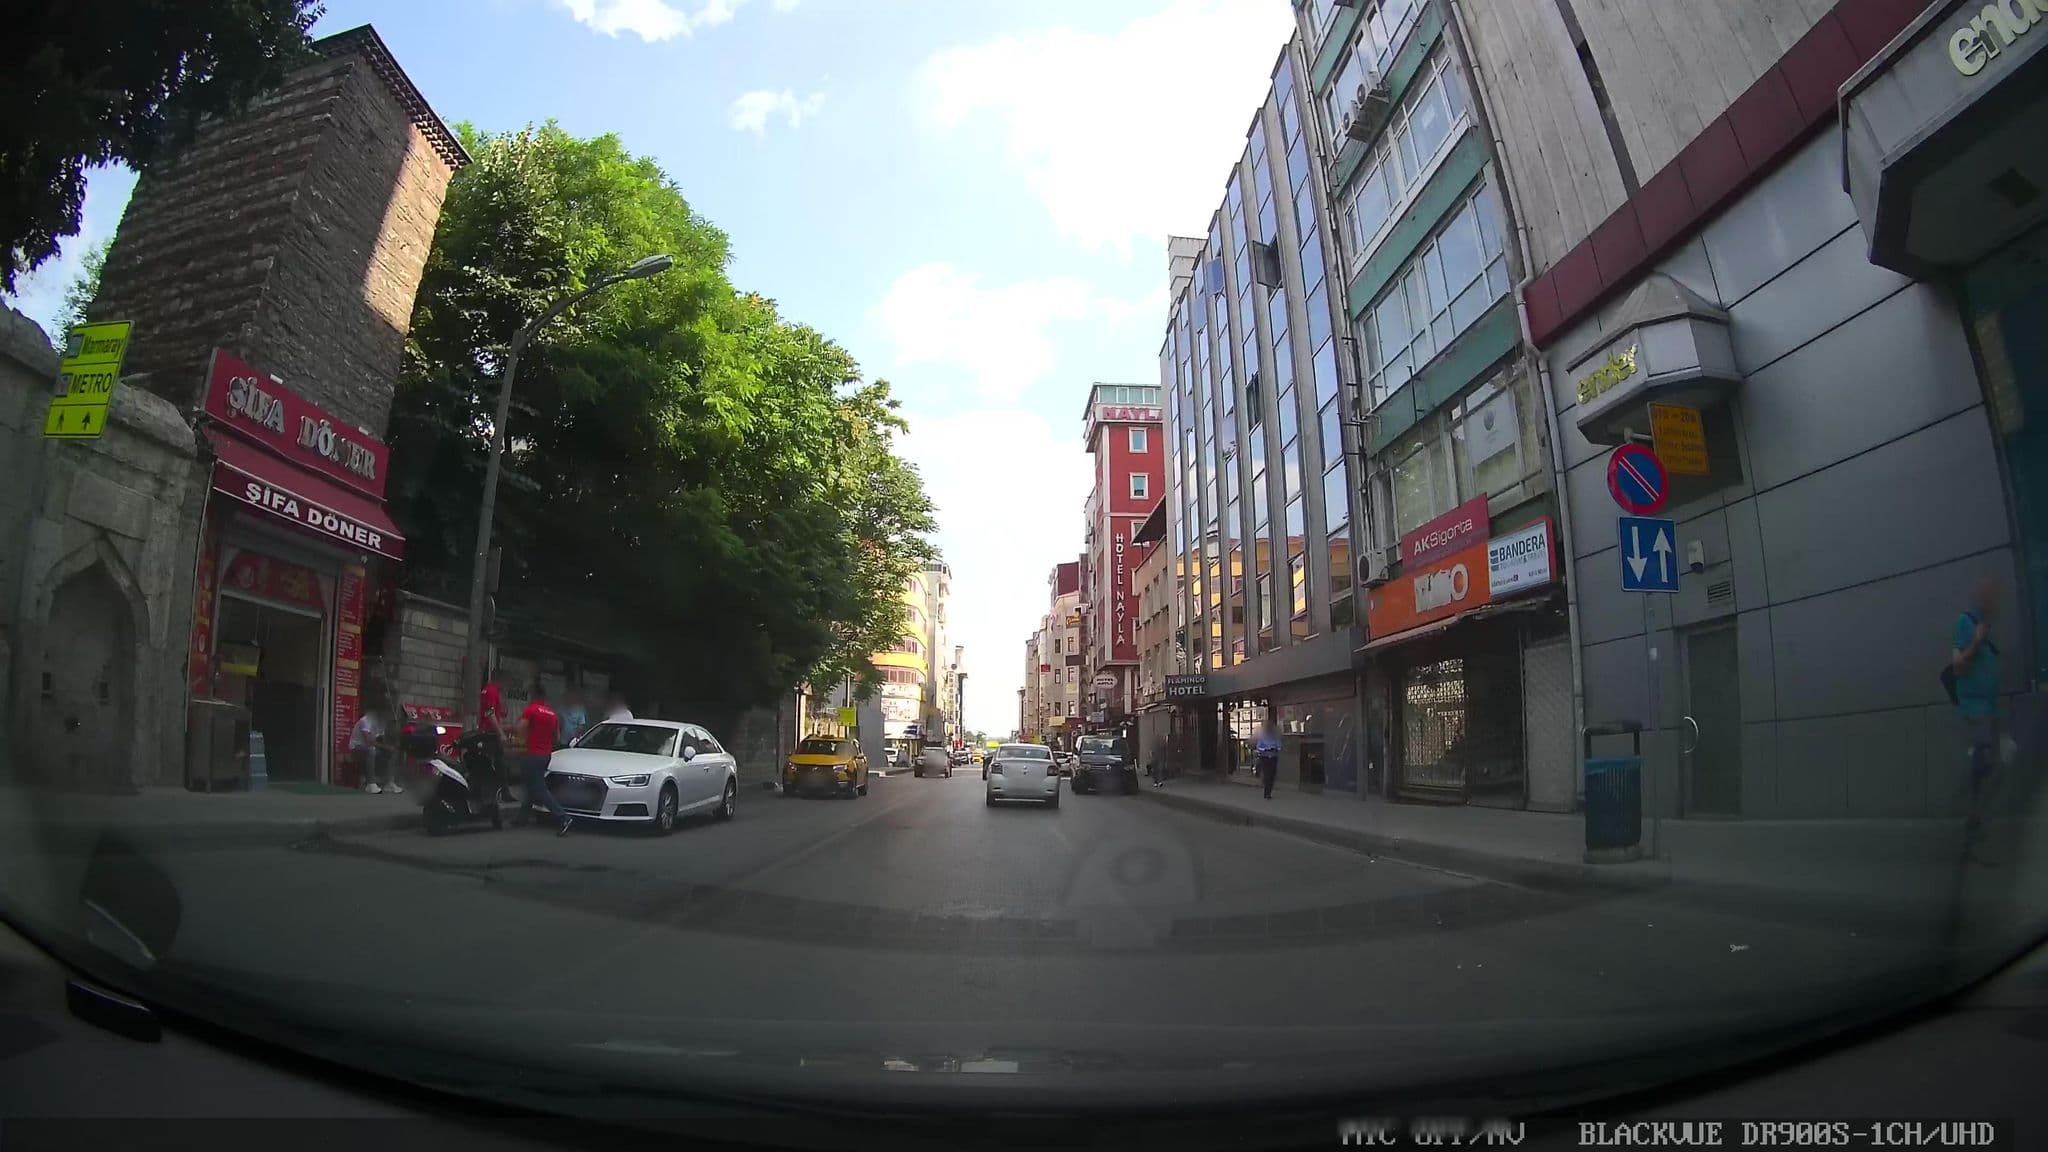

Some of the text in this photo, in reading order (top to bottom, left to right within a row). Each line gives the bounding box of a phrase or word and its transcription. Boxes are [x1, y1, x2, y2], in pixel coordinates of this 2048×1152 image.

[70, 373, 112, 394] METRO
[227, 376, 376, 480] ŞİFA DÖNER
[245, 483, 381, 549] ŞİFA DÖNER
[1414, 517, 1473, 556] AKSigorta
[1499, 533, 1546, 562] BANDERA
[1115, 532, 1125, 645] HOTEL NAYLA
[1169, 686, 1206, 695] HOTEL
